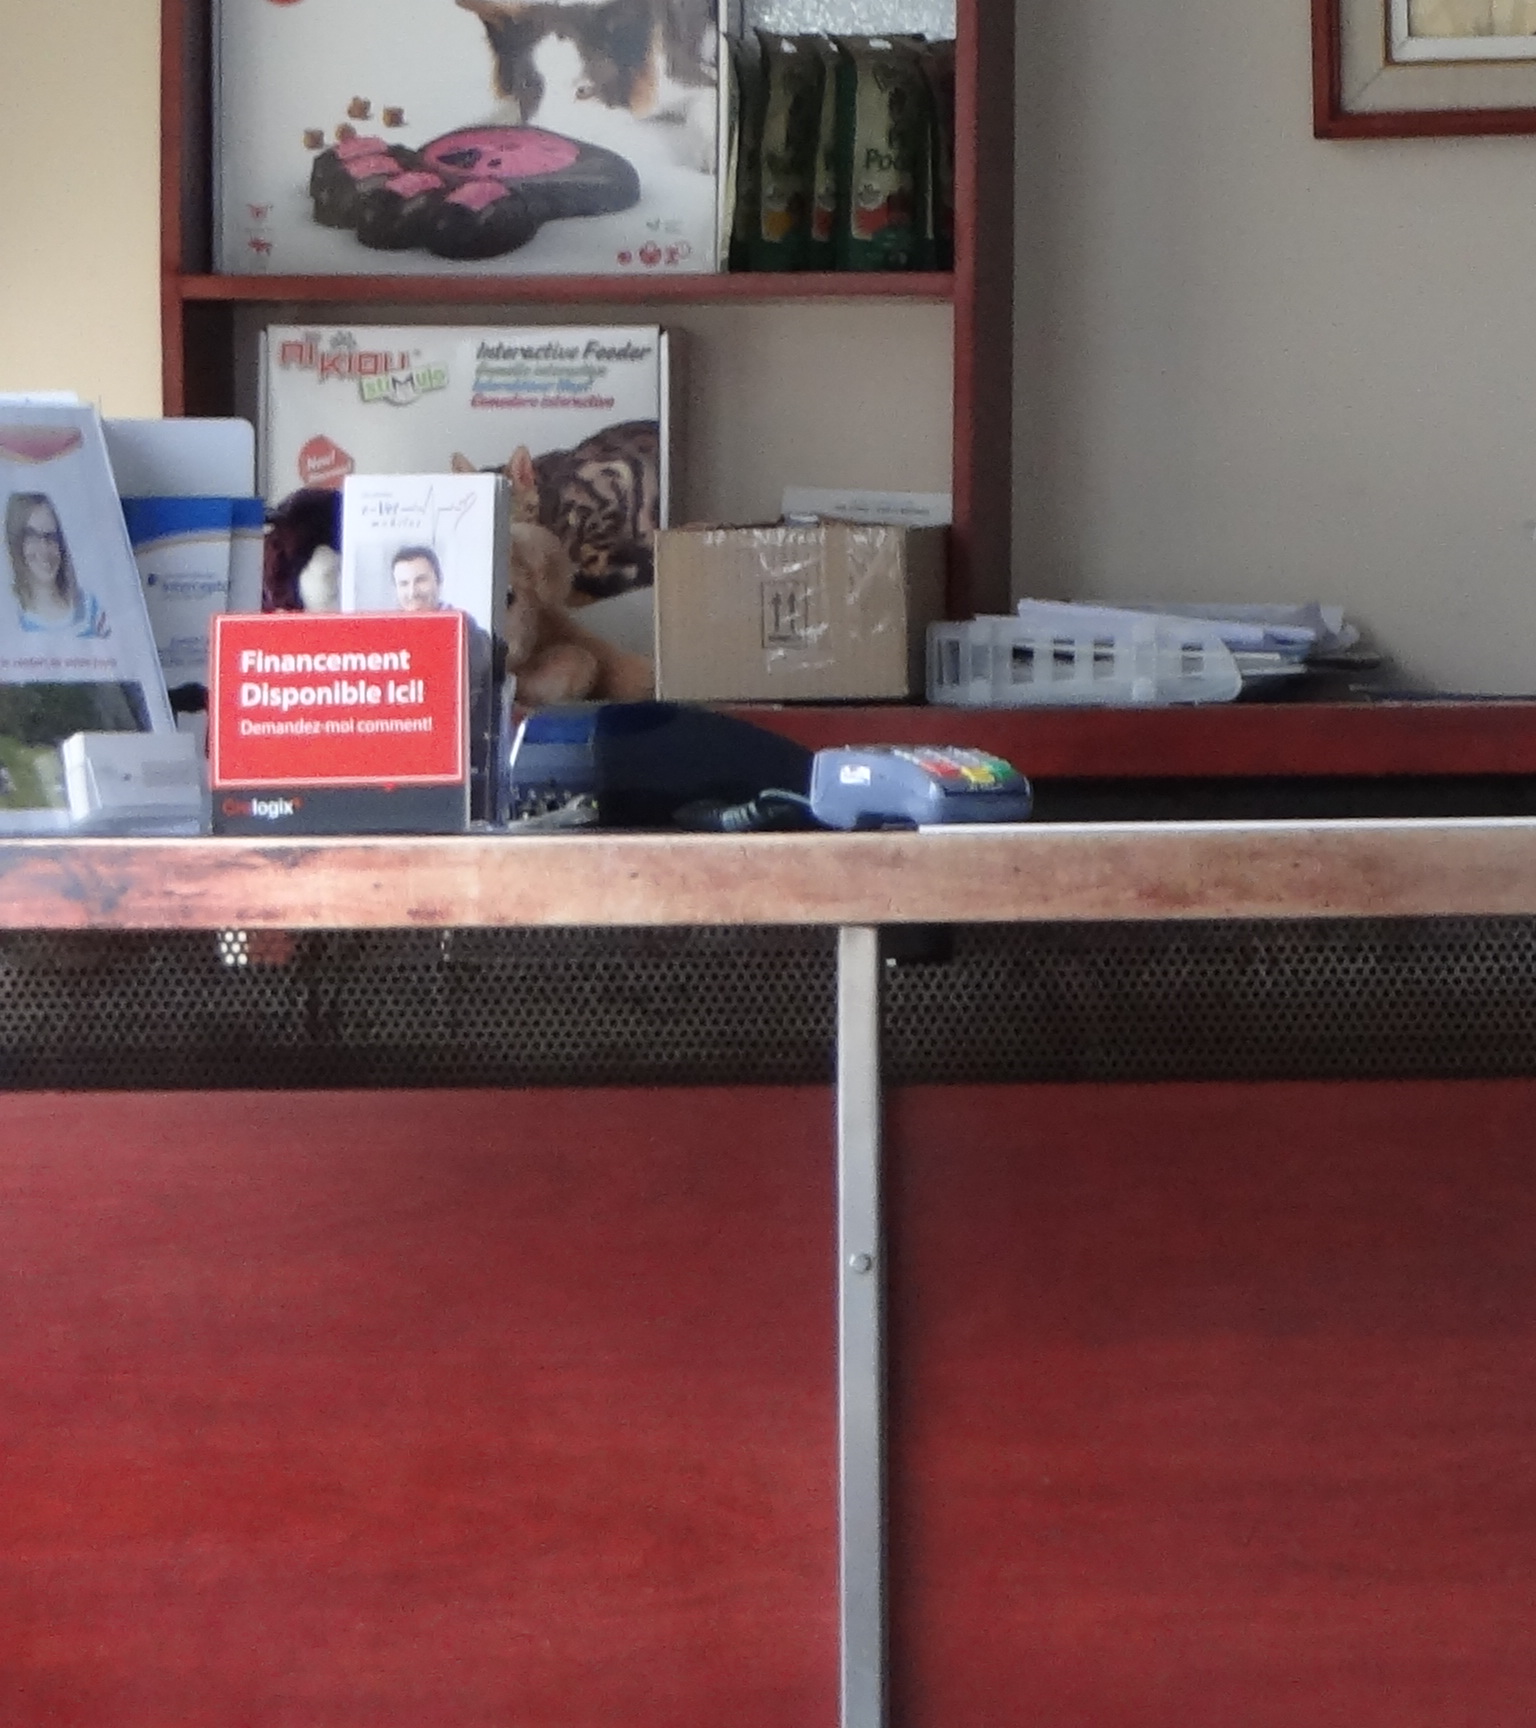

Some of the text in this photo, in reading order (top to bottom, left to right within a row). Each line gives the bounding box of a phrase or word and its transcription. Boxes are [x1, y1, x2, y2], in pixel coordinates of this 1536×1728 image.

[476, 341, 579, 361] Interactive
[240, 648, 412, 674] Financement
[240, 678, 425, 711] Disponible Ici!
[357, 715, 433, 735] comment!
